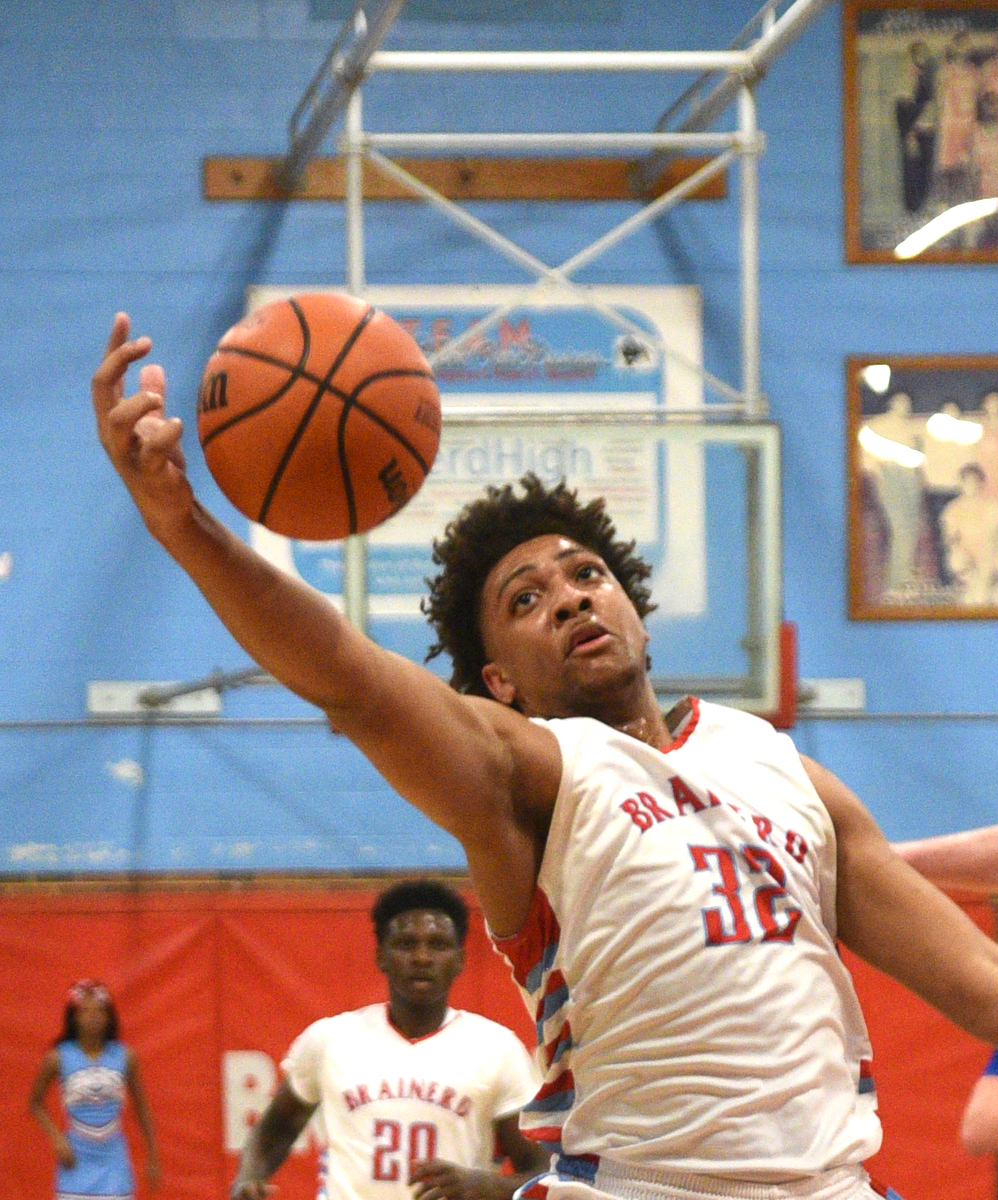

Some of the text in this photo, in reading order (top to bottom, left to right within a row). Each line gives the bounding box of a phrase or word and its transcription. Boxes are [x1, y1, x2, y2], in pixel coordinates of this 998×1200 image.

[687, 842, 802, 947] 32
[342, 1077, 472, 1117] BRAINERD
[373, 1118, 438, 1182] 20
